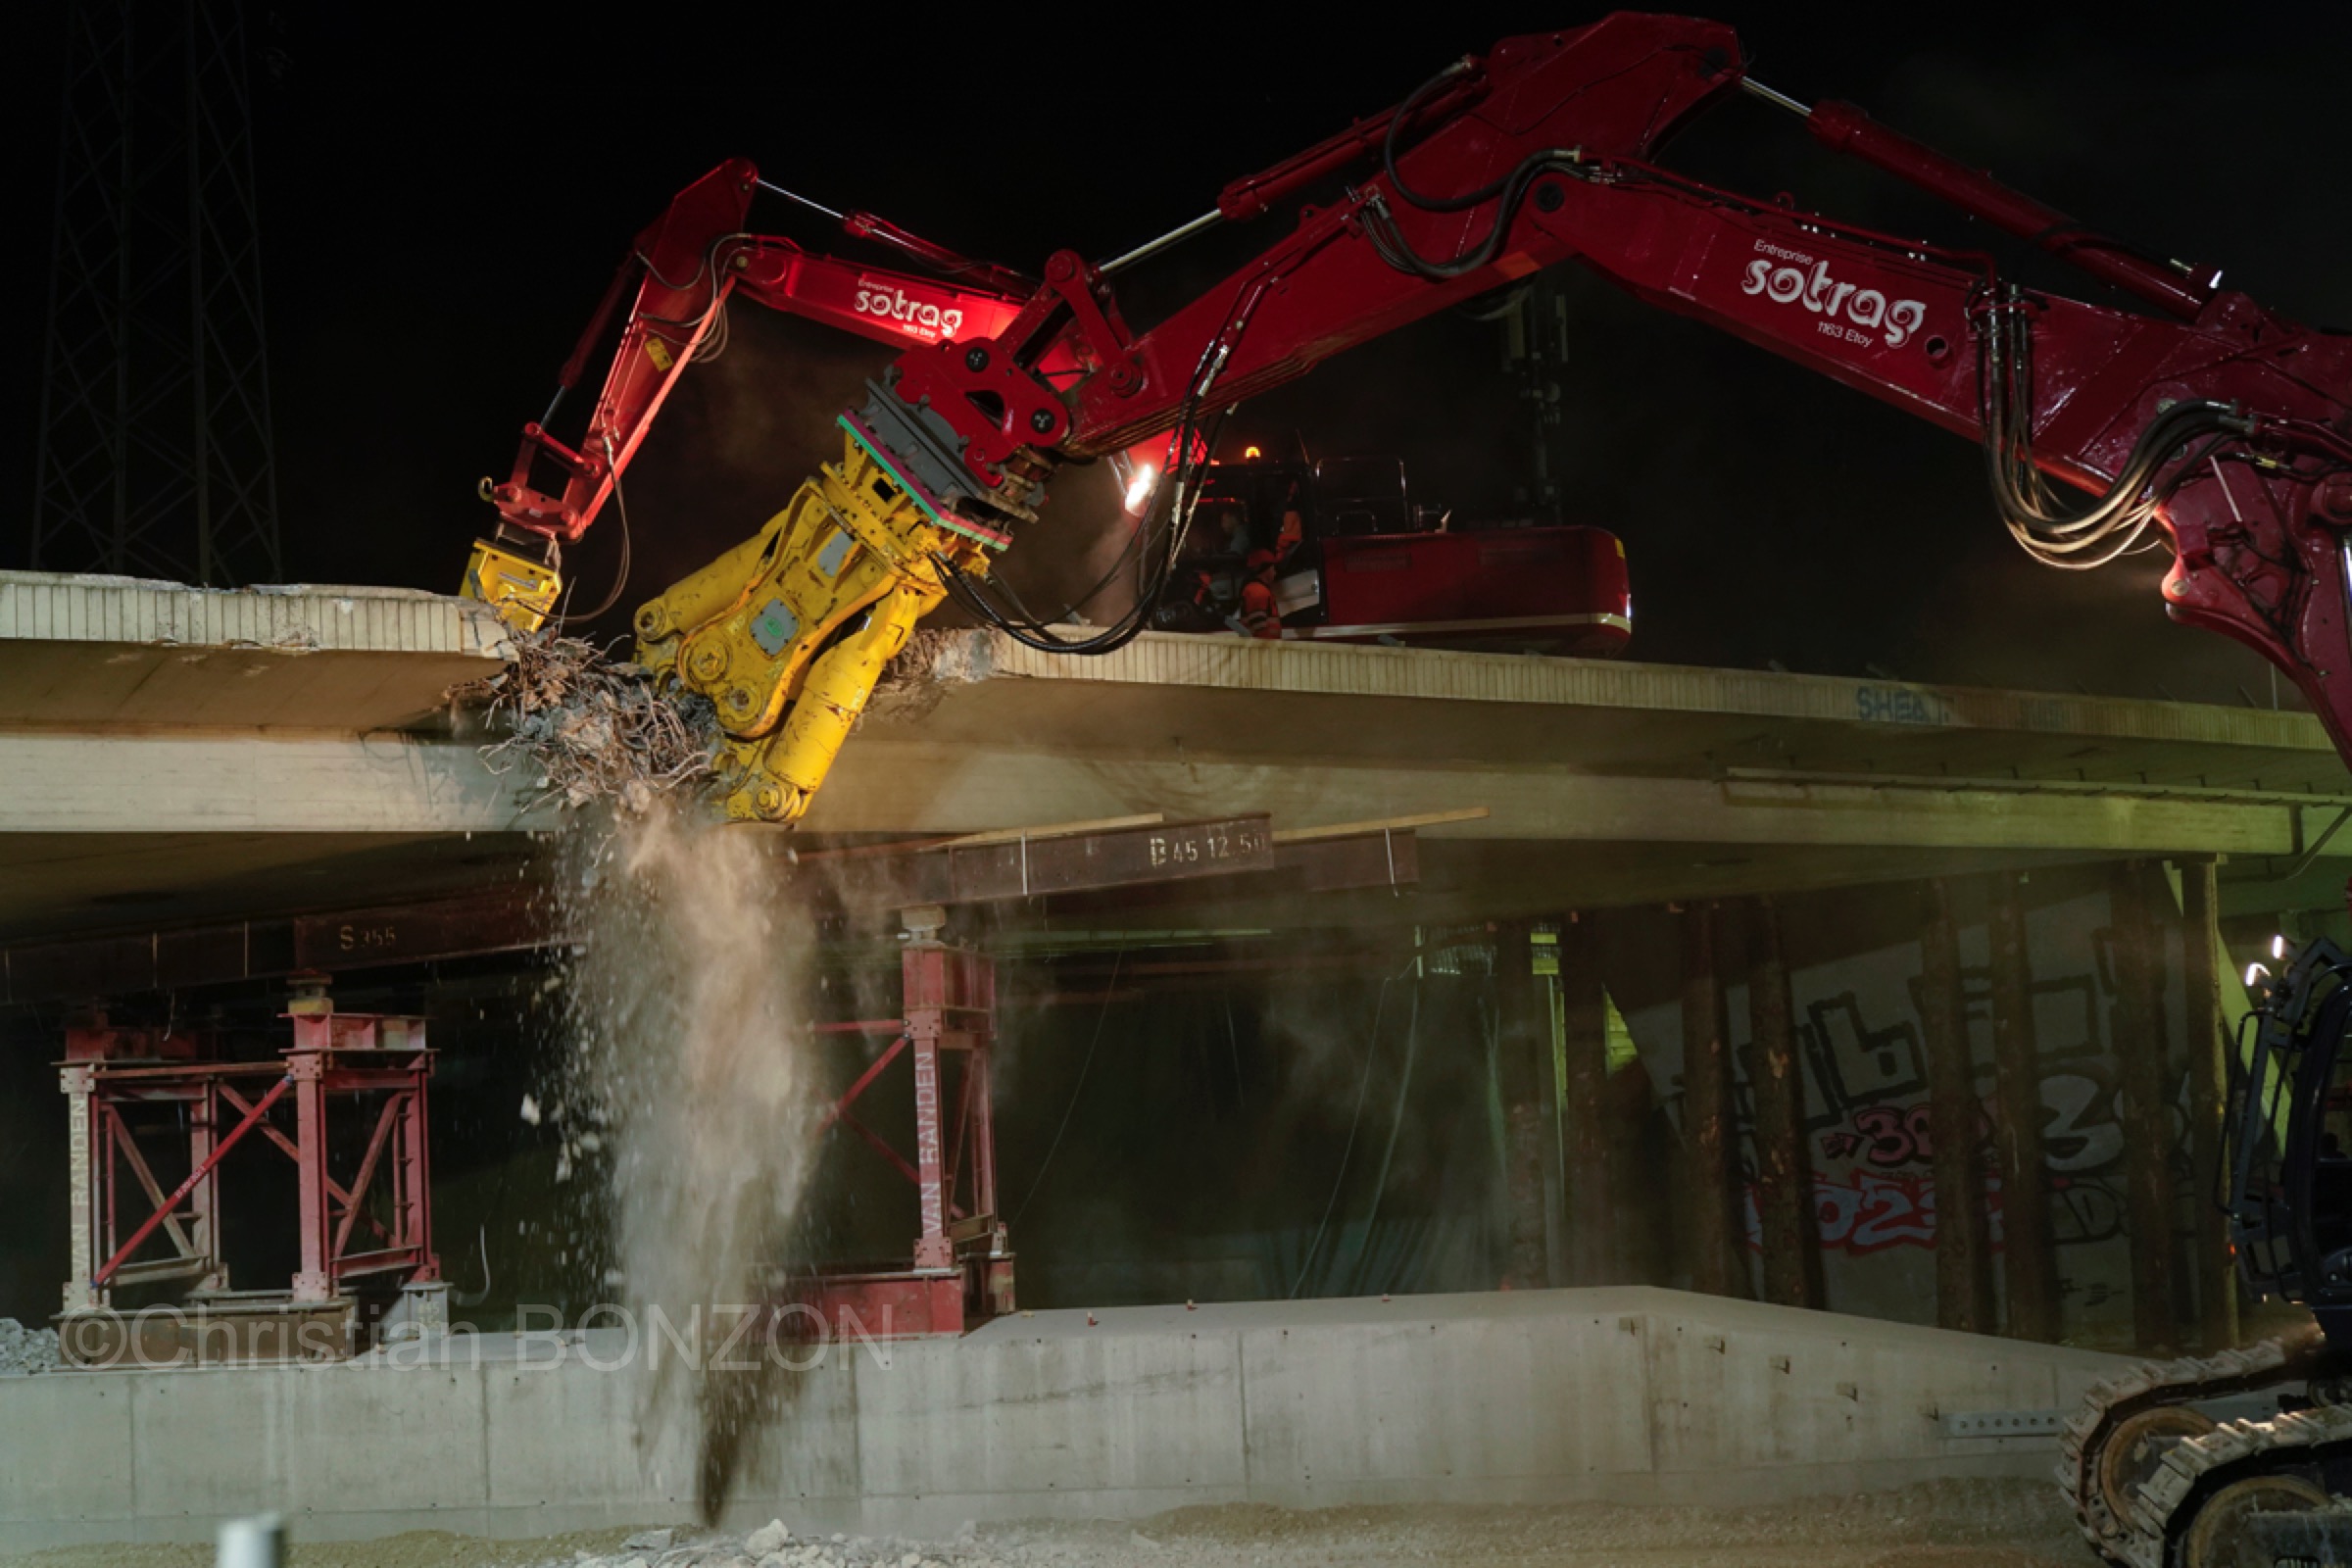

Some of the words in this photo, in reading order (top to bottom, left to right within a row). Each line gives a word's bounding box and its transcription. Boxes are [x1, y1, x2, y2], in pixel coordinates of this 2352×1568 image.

[1753, 238, 1813, 266] Entreprise
[854, 288, 963, 338] sotrag
[1740, 259, 1928, 349] sotrag
[1844, 328, 1874, 348] Etoy
[921, 1181, 942, 1234] VAN
